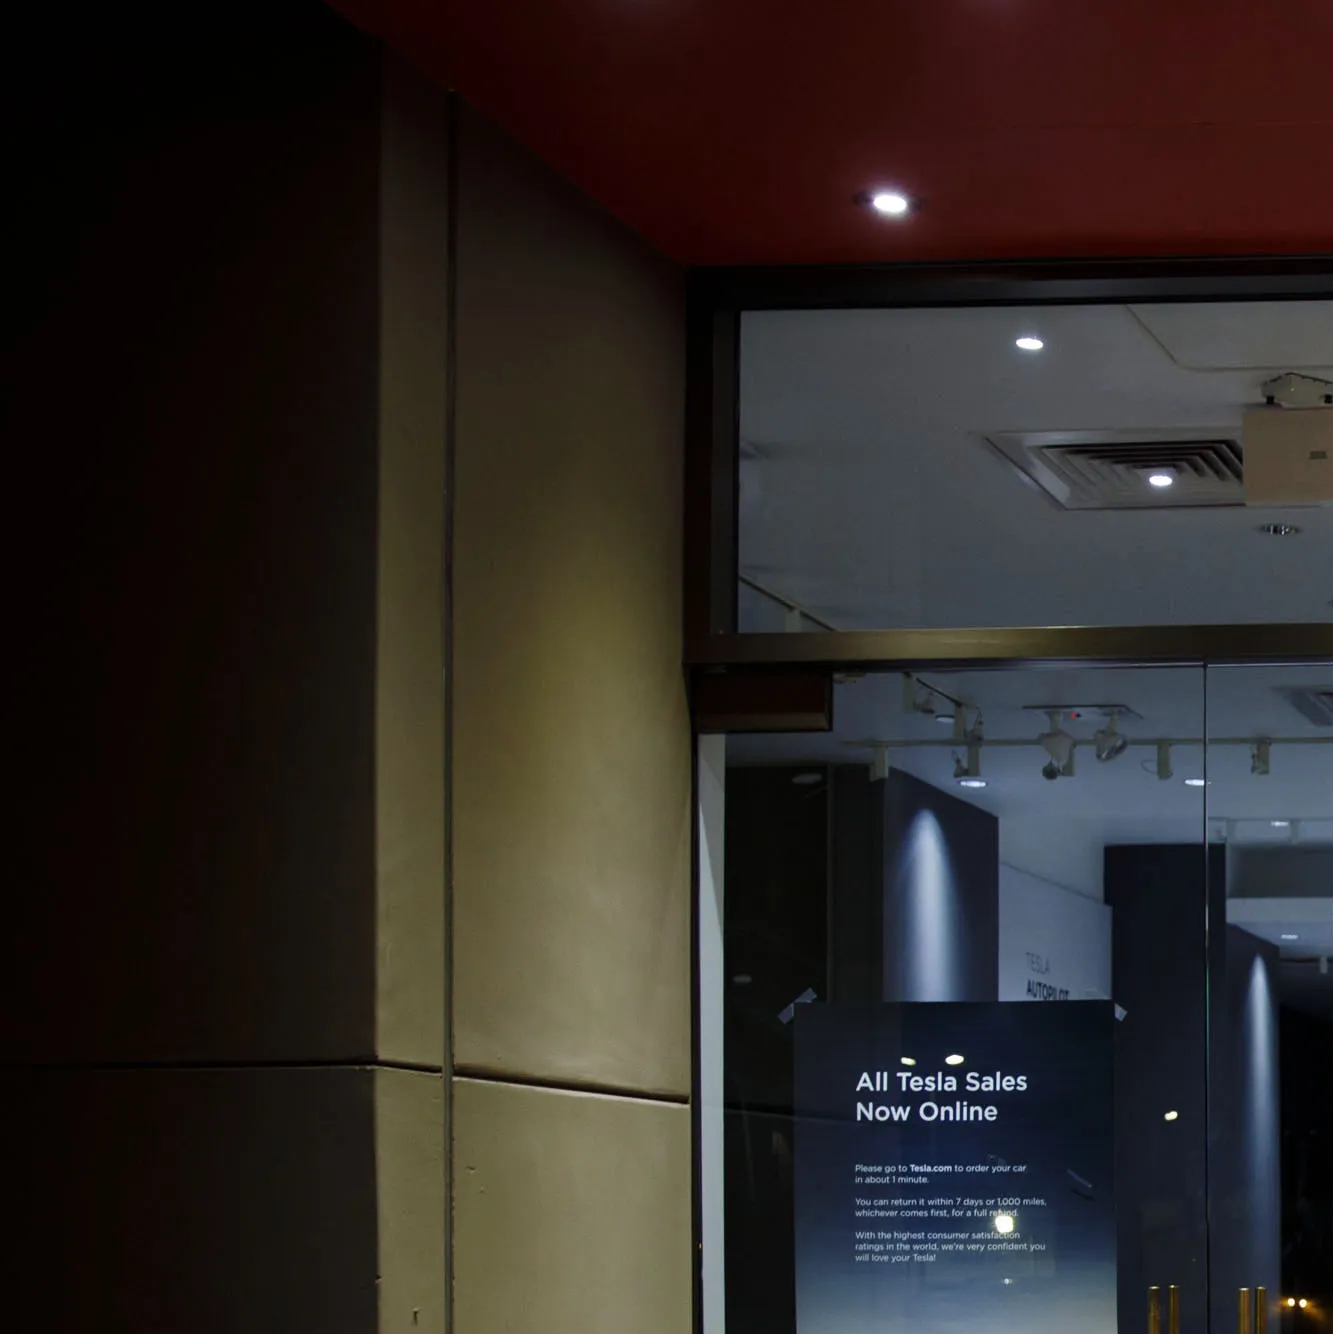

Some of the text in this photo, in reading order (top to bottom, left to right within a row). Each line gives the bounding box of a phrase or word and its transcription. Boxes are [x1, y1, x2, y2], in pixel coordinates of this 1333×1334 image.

[856, 1071, 1028, 1092] All Tesla Sales
[856, 1101, 998, 1122] Now Online
[855, 1164, 1027, 1175] Please go to Tesla.com to order your car
[855, 1175, 930, 1184] in about 1 minute.
[855, 1198, 872, 1208] You
[873, 1199, 890, 1207] can
[890, 1198, 918, 1207] return
[918, 1197, 926, 1207] it
[927, 1197, 954, 1207] within
[955, 1197, 962, 1207] 7
[963, 1197, 984, 1209] days
[985, 1199, 996, 1207] or
[855, 1208, 899, 1218] whichever
[900, 1210, 929, 1218] comes
[930, 1208, 950, 1219] first,
[951, 1208, 965, 1218] for
[966, 1210, 972, 1218] a
[973, 1208, 988, 1218] full
[855, 1231, 1021, 1242] With the highest consumer satisfaction
[855, 1242, 885, 1253] ratings
[886, 1242, 895, 1251] in
[896, 1242, 911, 1251] the
[940, 1242, 965, 1252] we're
[966, 1244, 986, 1253] very
[987, 1242, 1028, 1252] confident
[1029, 1244, 1046, 1253] you
[855, 1253, 937, 1265] will love your Tesla!
